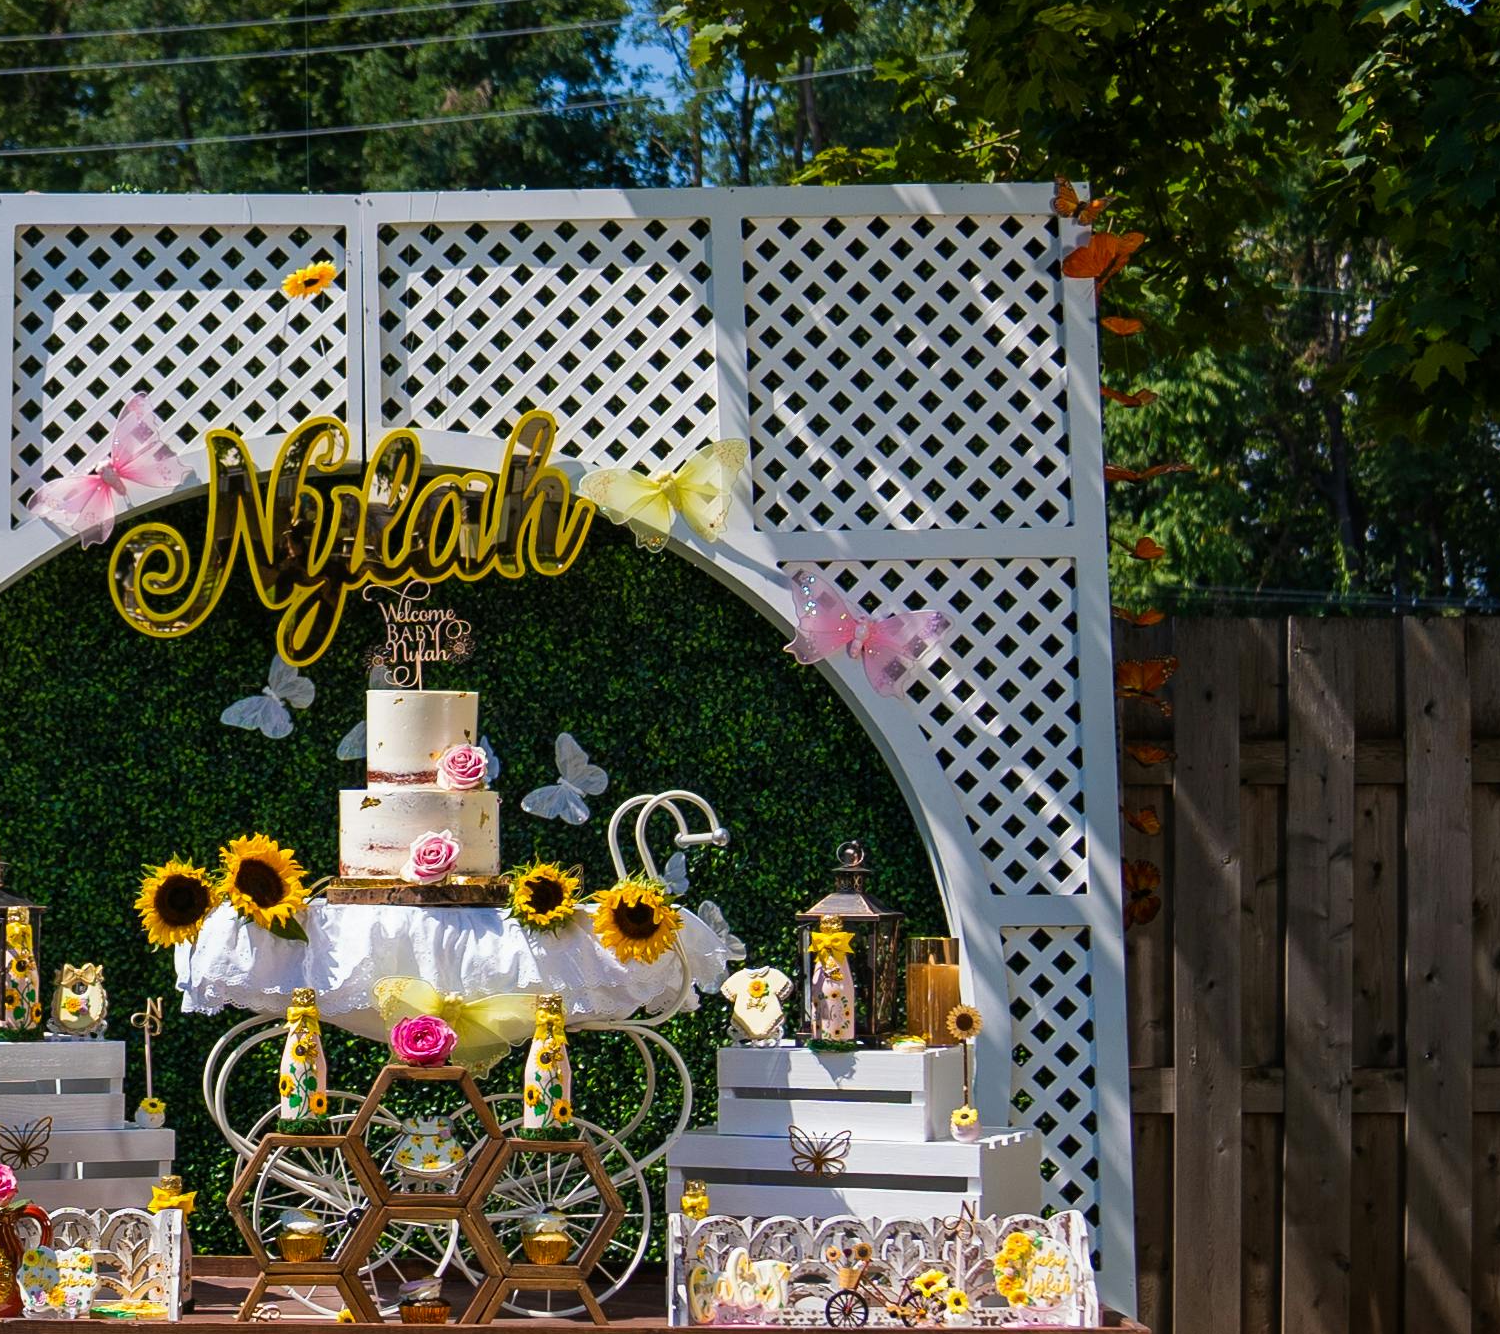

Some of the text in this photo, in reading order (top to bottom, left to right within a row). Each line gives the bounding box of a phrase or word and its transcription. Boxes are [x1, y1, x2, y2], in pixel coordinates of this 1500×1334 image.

[108, 409, 598, 667] Nylah
[363, 579, 457, 623] Welcome
[386, 623, 439, 643] BABY
